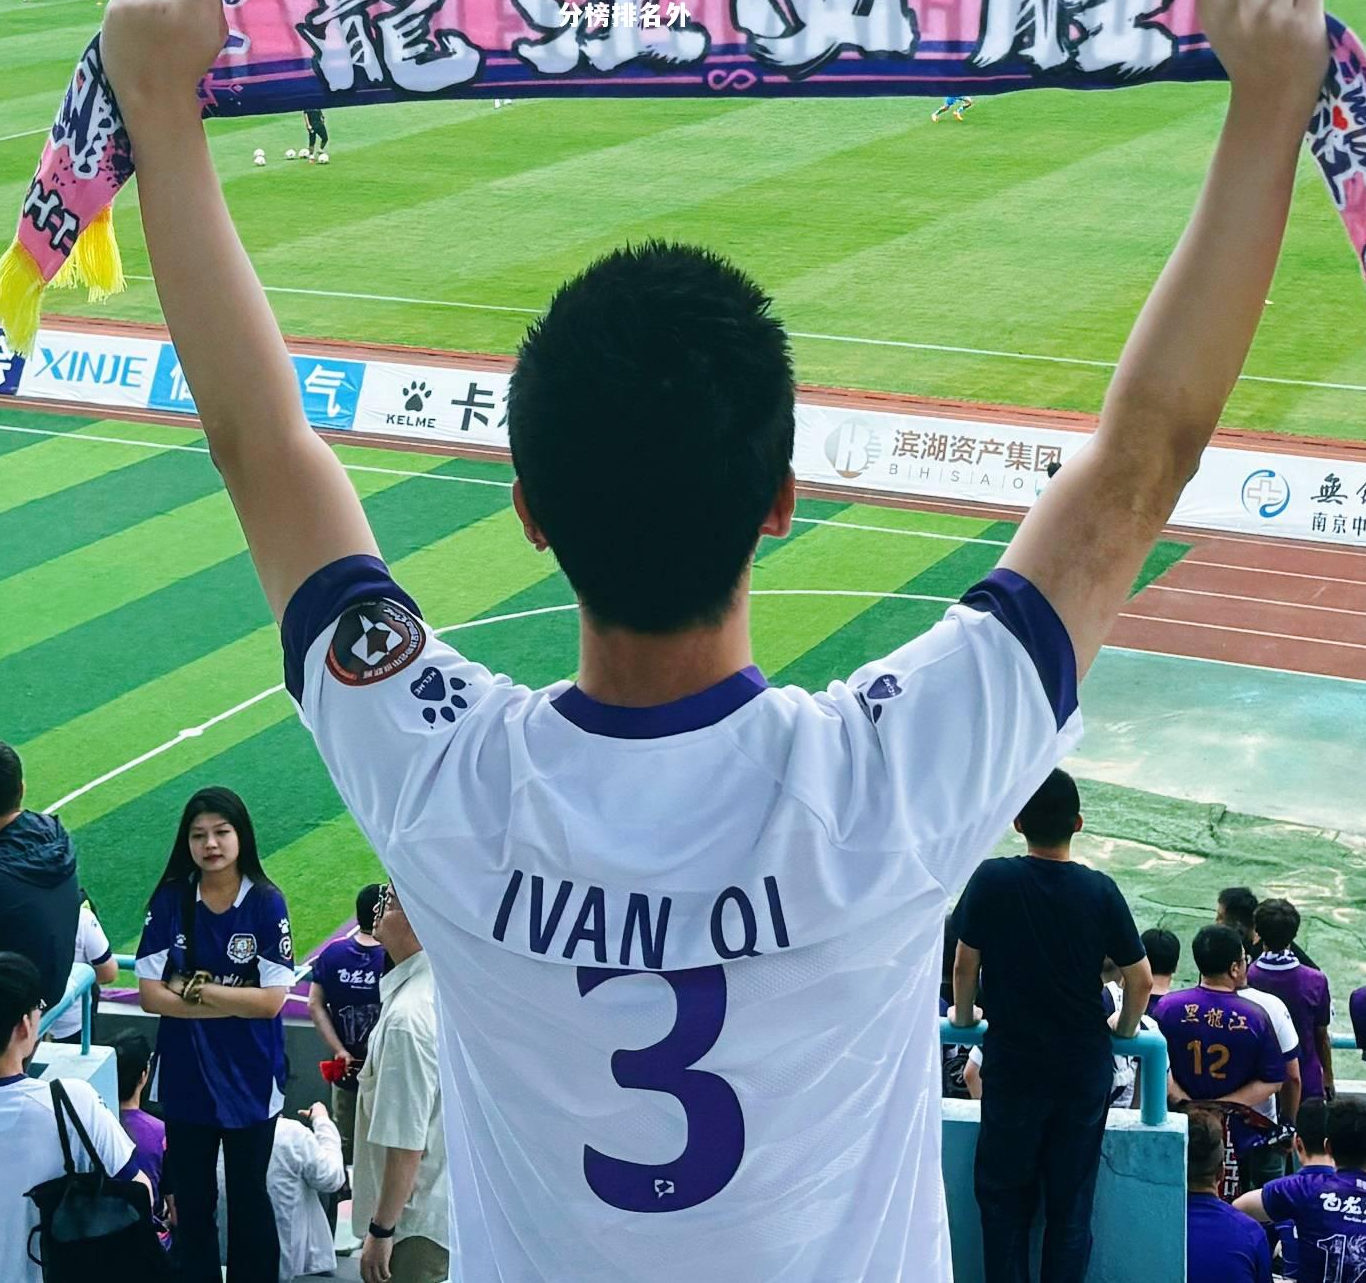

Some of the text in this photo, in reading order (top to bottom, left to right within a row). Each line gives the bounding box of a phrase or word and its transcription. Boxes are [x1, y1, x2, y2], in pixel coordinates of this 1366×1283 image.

[35, 347, 148, 388] XINJE
[385, 413, 436, 429] KELME
[891, 429, 1063, 473] 滨湖资产集团
[492, 869, 790, 970] IVAN QI
[1186, 1039, 1230, 1079] 12
[576, 964, 746, 1213] 3
